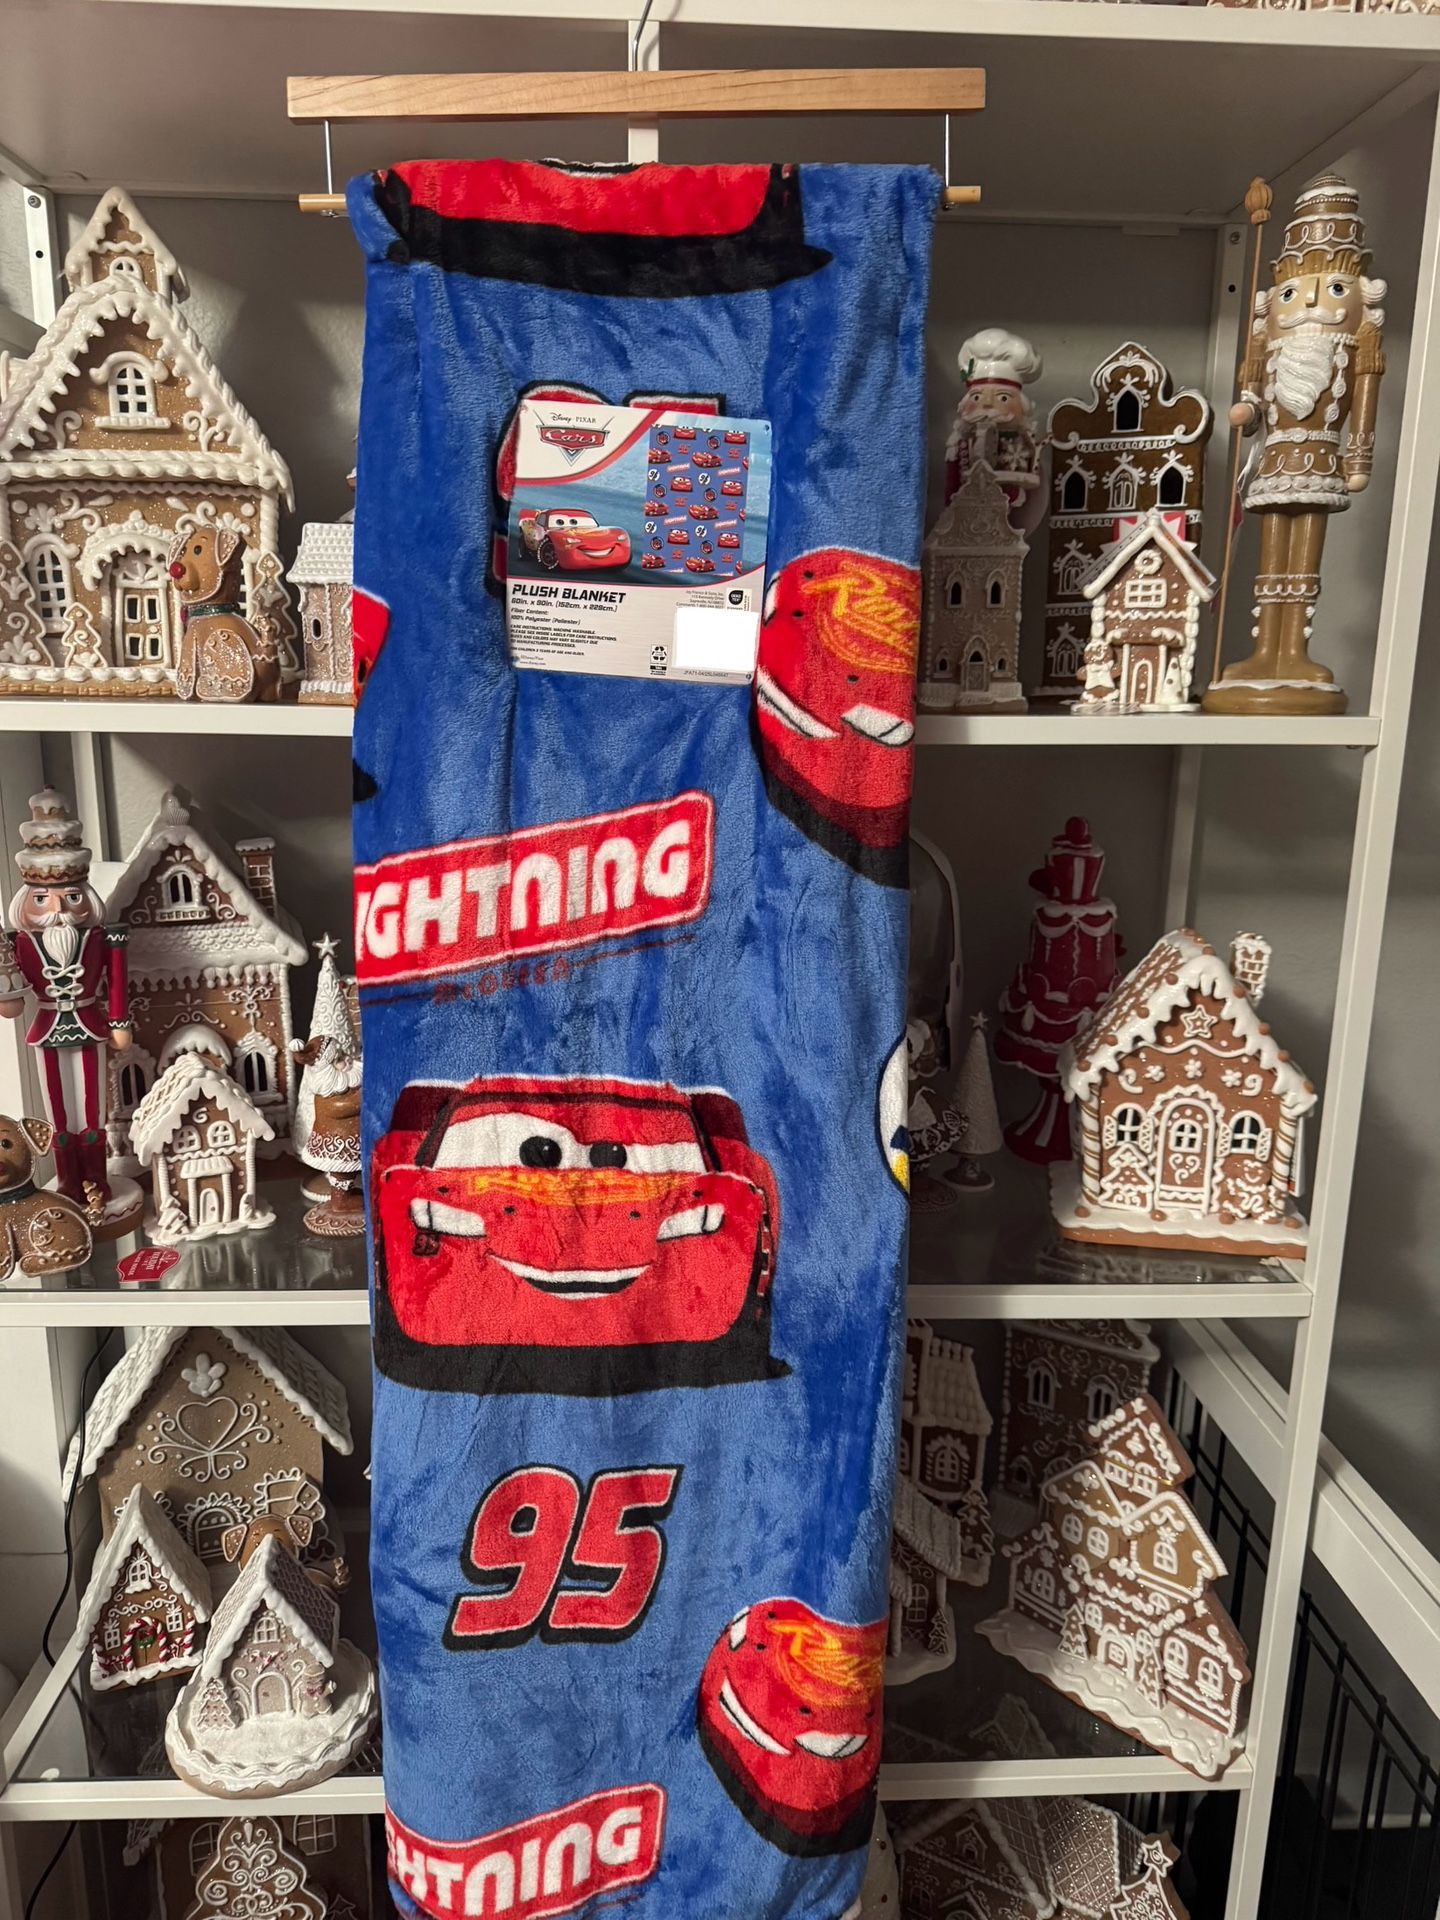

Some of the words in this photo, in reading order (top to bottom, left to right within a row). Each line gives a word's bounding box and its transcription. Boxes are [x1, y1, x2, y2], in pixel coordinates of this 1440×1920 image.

[549, 412, 572, 423] Disney
[576, 415, 597, 424] PIXAR
[545, 429, 598, 444] Cars
[512, 584, 559, 598] PLUSH
[562, 588, 626, 603] BLANKET
[556, 600, 581, 609] (152cm.
[354, 819, 690, 961] IGHTNING
[444, 1465, 683, 1650] 95
[386, 1806, 643, 1917] HTNING
